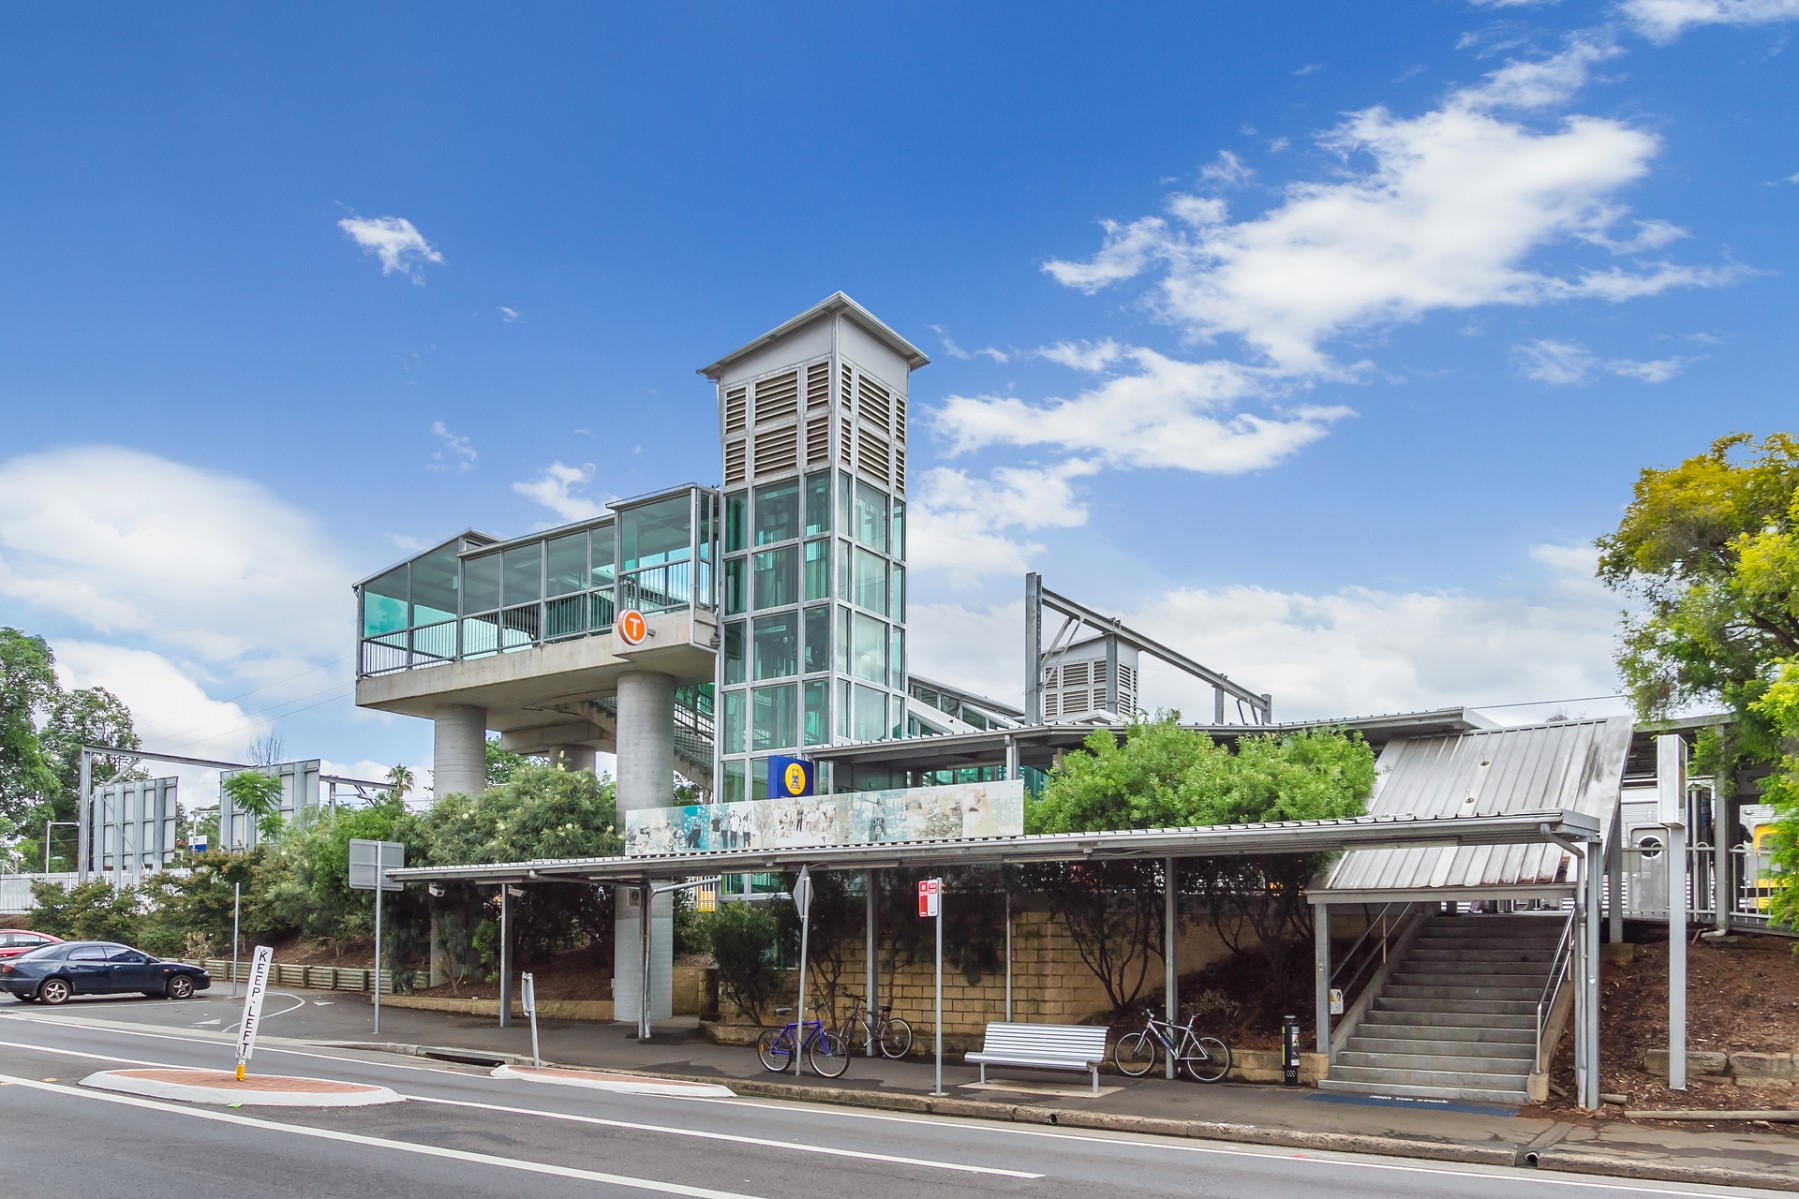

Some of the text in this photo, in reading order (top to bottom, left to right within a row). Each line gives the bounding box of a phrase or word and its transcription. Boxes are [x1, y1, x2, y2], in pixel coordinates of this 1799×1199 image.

[629, 617, 640, 637] T
[242, 950, 267, 1056] KEEP LEFT
